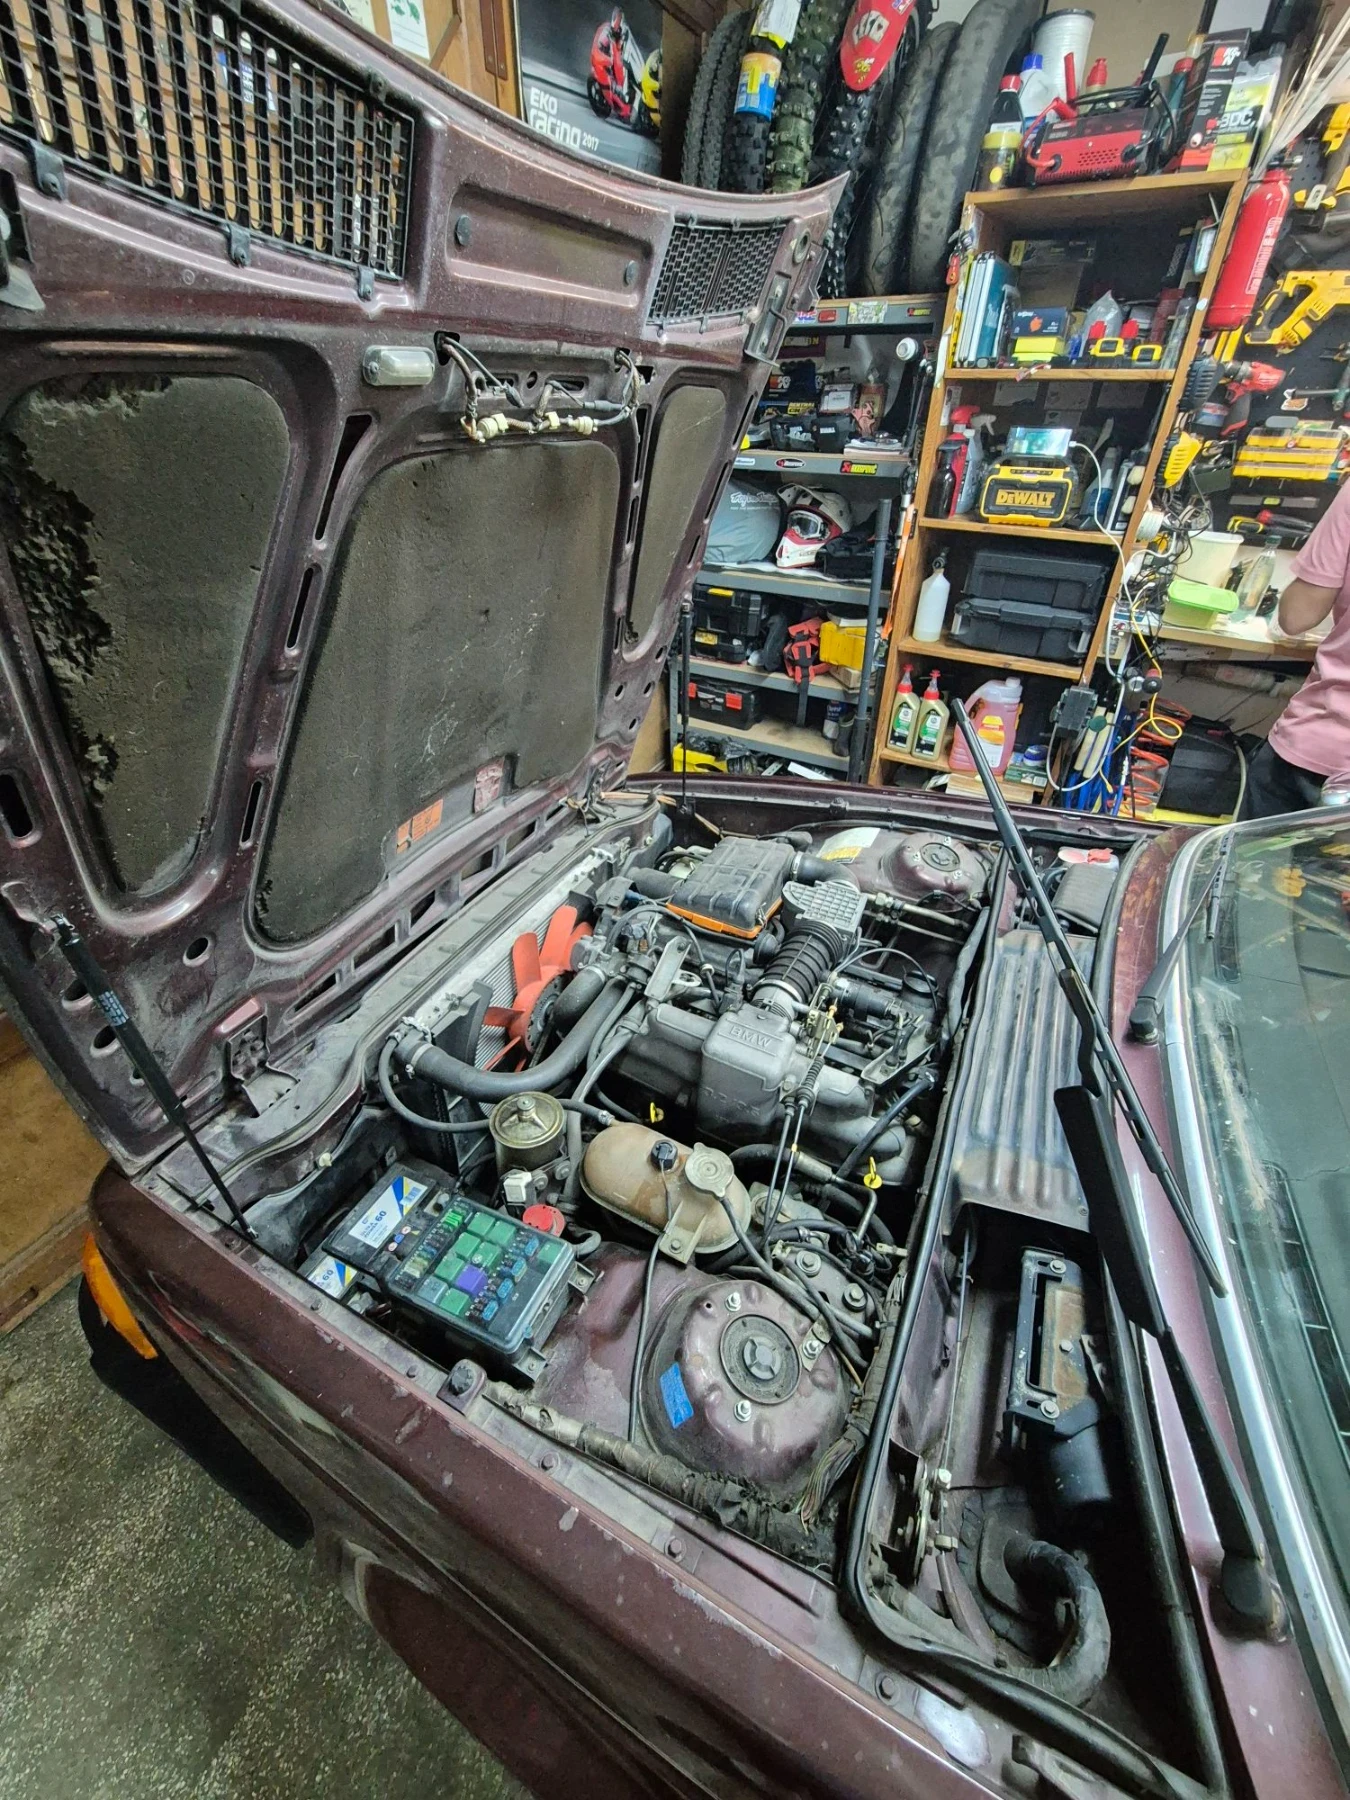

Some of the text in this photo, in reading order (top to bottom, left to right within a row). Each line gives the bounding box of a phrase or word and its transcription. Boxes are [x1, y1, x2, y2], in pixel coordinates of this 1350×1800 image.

[530, 86, 558, 116] EKO
[582, 132, 600, 152] 2017
[996, 489, 1056, 509] DEWALT
[730, 1025, 772, 1048] BMW
[375, 1210, 387, 1222] 60
[322, 1269, 334, 1281] 60
